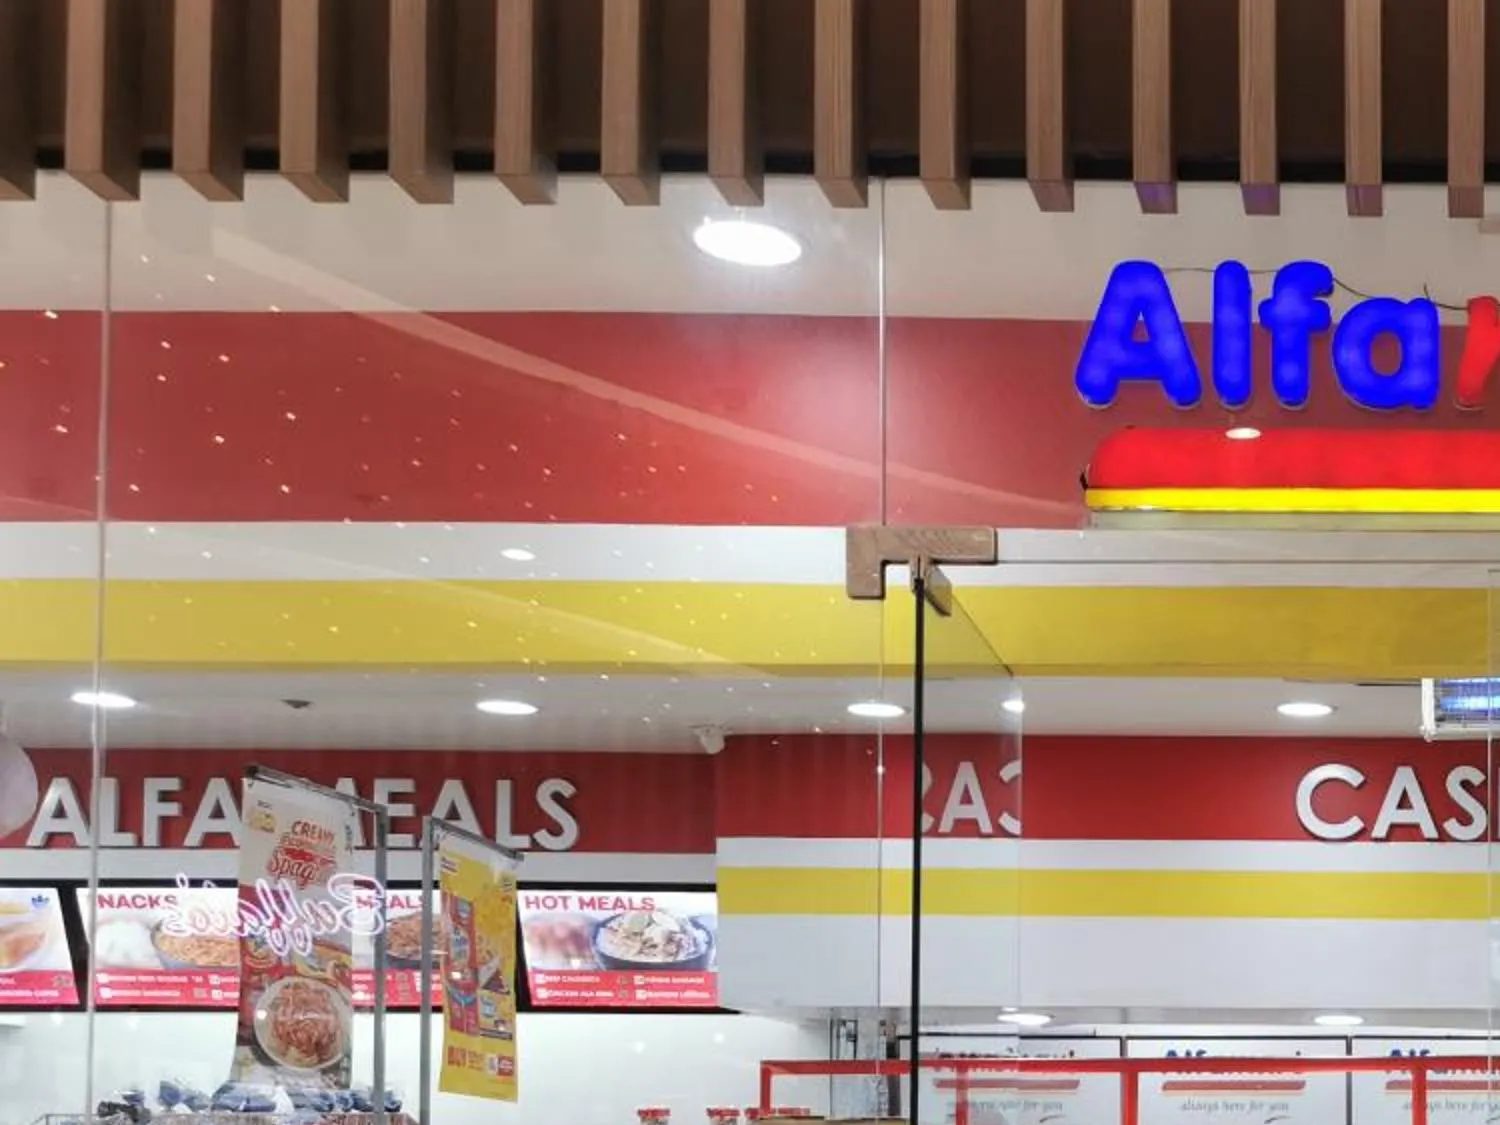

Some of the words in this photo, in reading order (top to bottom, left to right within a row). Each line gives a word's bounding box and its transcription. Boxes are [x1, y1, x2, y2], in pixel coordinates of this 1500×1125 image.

[27, 777, 243, 848] ALFA
[97, 893, 178, 910] NACKS
[525, 895, 572, 910] HOT
[578, 896, 656, 911] MEALS
